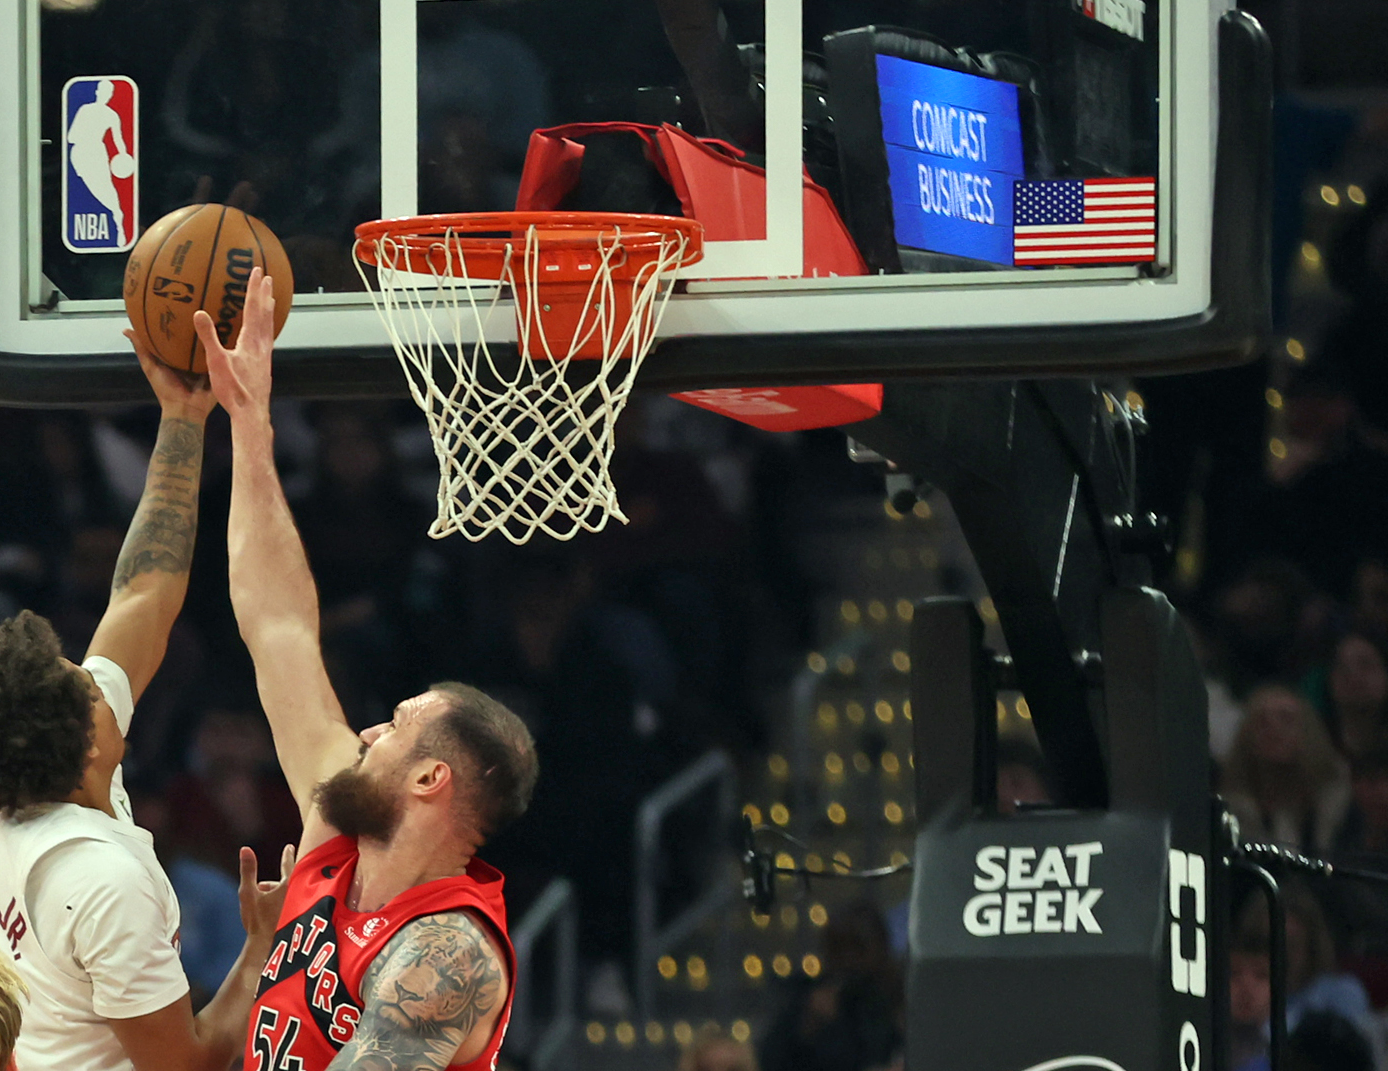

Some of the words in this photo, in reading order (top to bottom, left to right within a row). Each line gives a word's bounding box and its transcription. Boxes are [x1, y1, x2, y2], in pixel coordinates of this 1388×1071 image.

[912, 99, 987, 162] COMCAST
[917, 163, 995, 225] BUSINESS
[73, 212, 110, 241] NBA
[219, 247, 255, 346] Wilso
[973, 841, 1104, 892] SEAT
[963, 888, 1105, 937] GEEK
[255, 914, 362, 1045] APTORS
